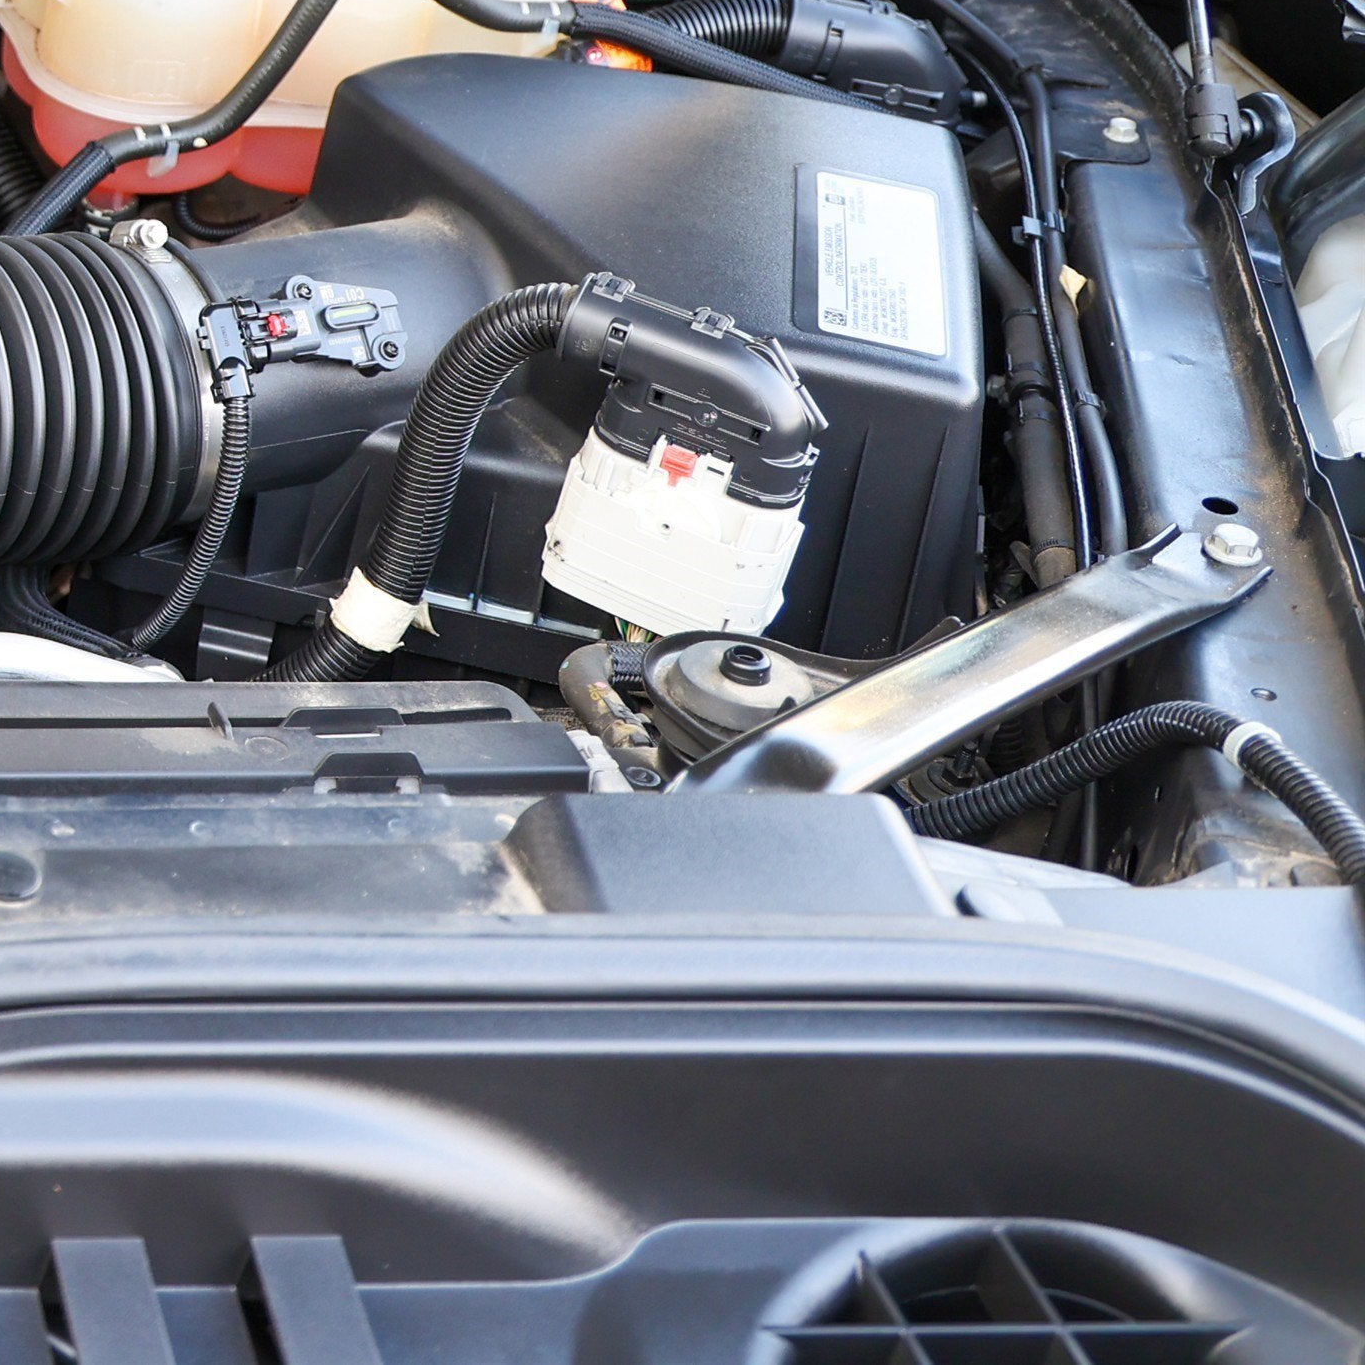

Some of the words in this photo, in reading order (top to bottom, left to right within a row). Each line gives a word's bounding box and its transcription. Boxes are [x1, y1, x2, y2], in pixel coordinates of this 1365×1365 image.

[834, 221, 843, 258] INFORMATION
[824, 252, 833, 276] VEHICLE
[835, 259, 844, 287] CONTROL
